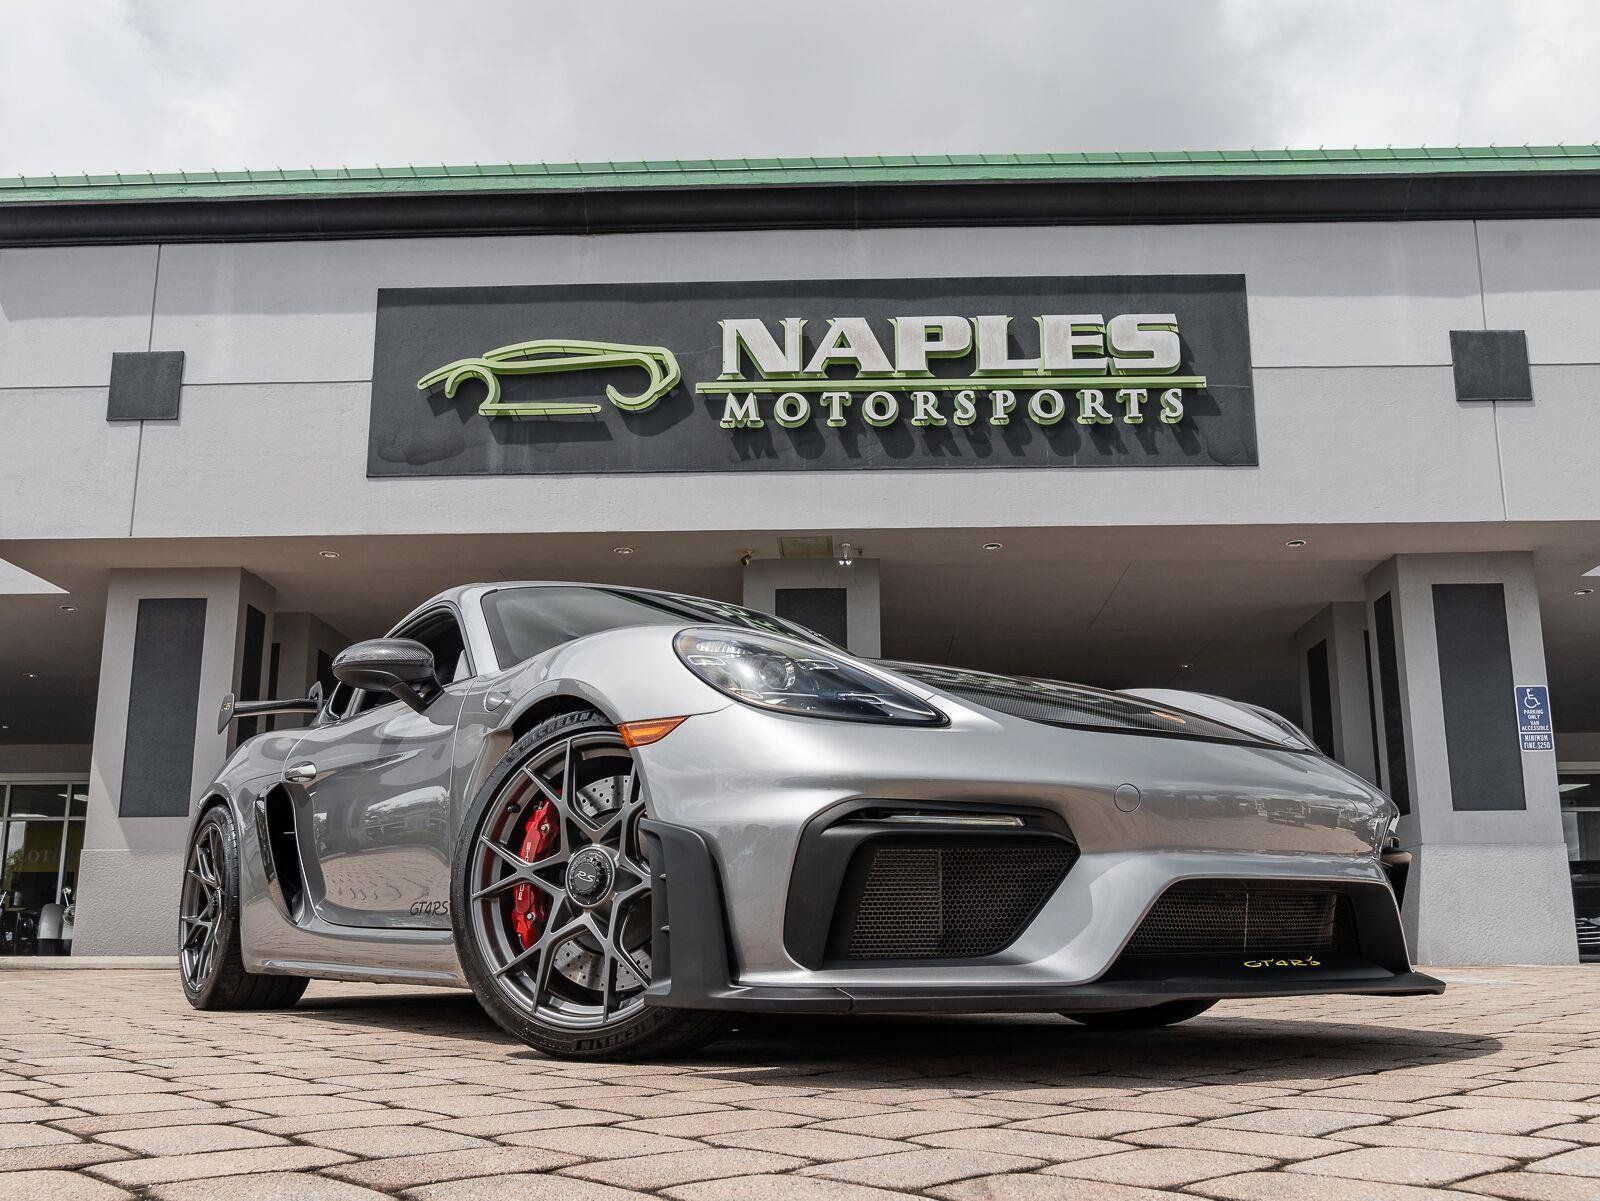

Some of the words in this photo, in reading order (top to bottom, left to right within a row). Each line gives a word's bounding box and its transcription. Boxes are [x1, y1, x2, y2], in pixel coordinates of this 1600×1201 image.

[717, 313, 1181, 380] NAPLES
[719, 388, 1185, 428] MOTORSPORTS
[575, 870, 596, 882] RS
[410, 900, 449, 916] GT4RS
